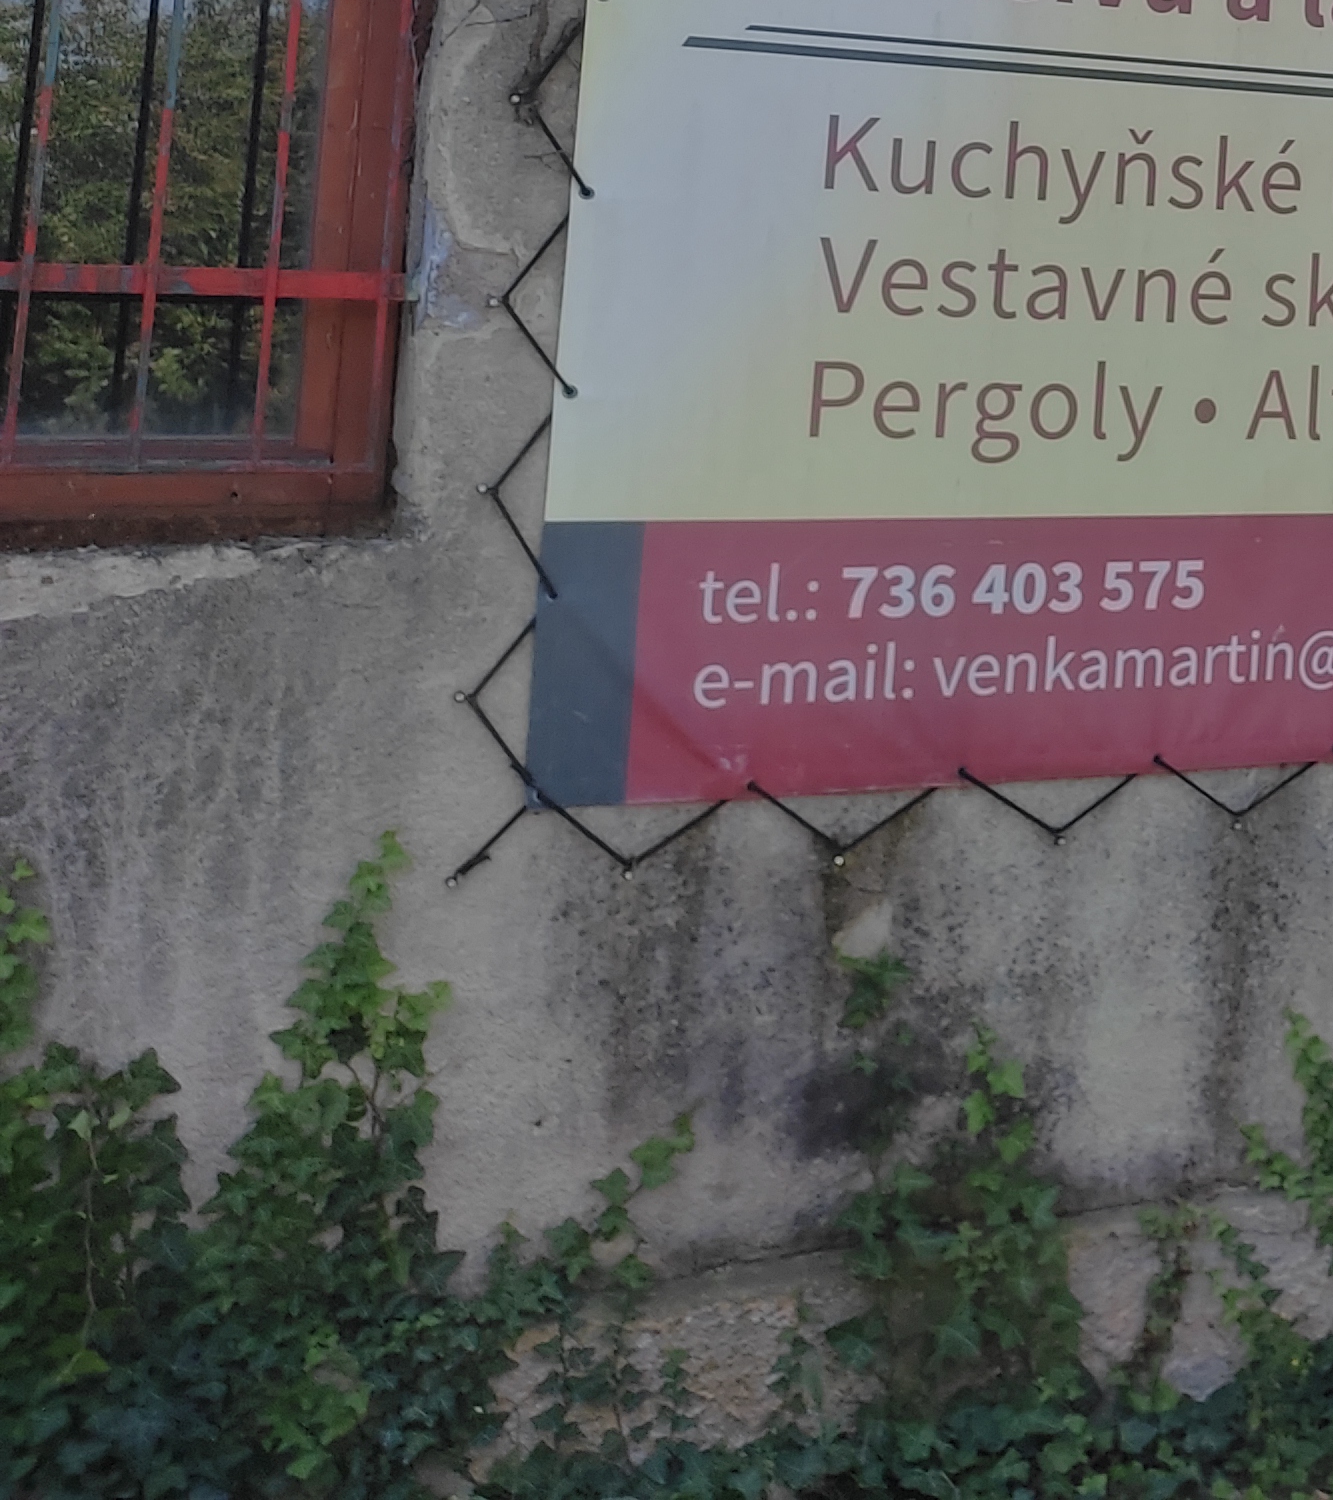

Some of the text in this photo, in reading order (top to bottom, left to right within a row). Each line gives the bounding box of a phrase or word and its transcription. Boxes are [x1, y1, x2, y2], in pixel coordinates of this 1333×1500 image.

[823, 114, 1301, 228] Kuchyňské
[819, 236, 1234, 326] Vestavné
[807, 360, 1164, 464] Pergoly
[699, 559, 1205, 624] tel.: 736 403 575
[693, 640, 916, 710] e-mail:
